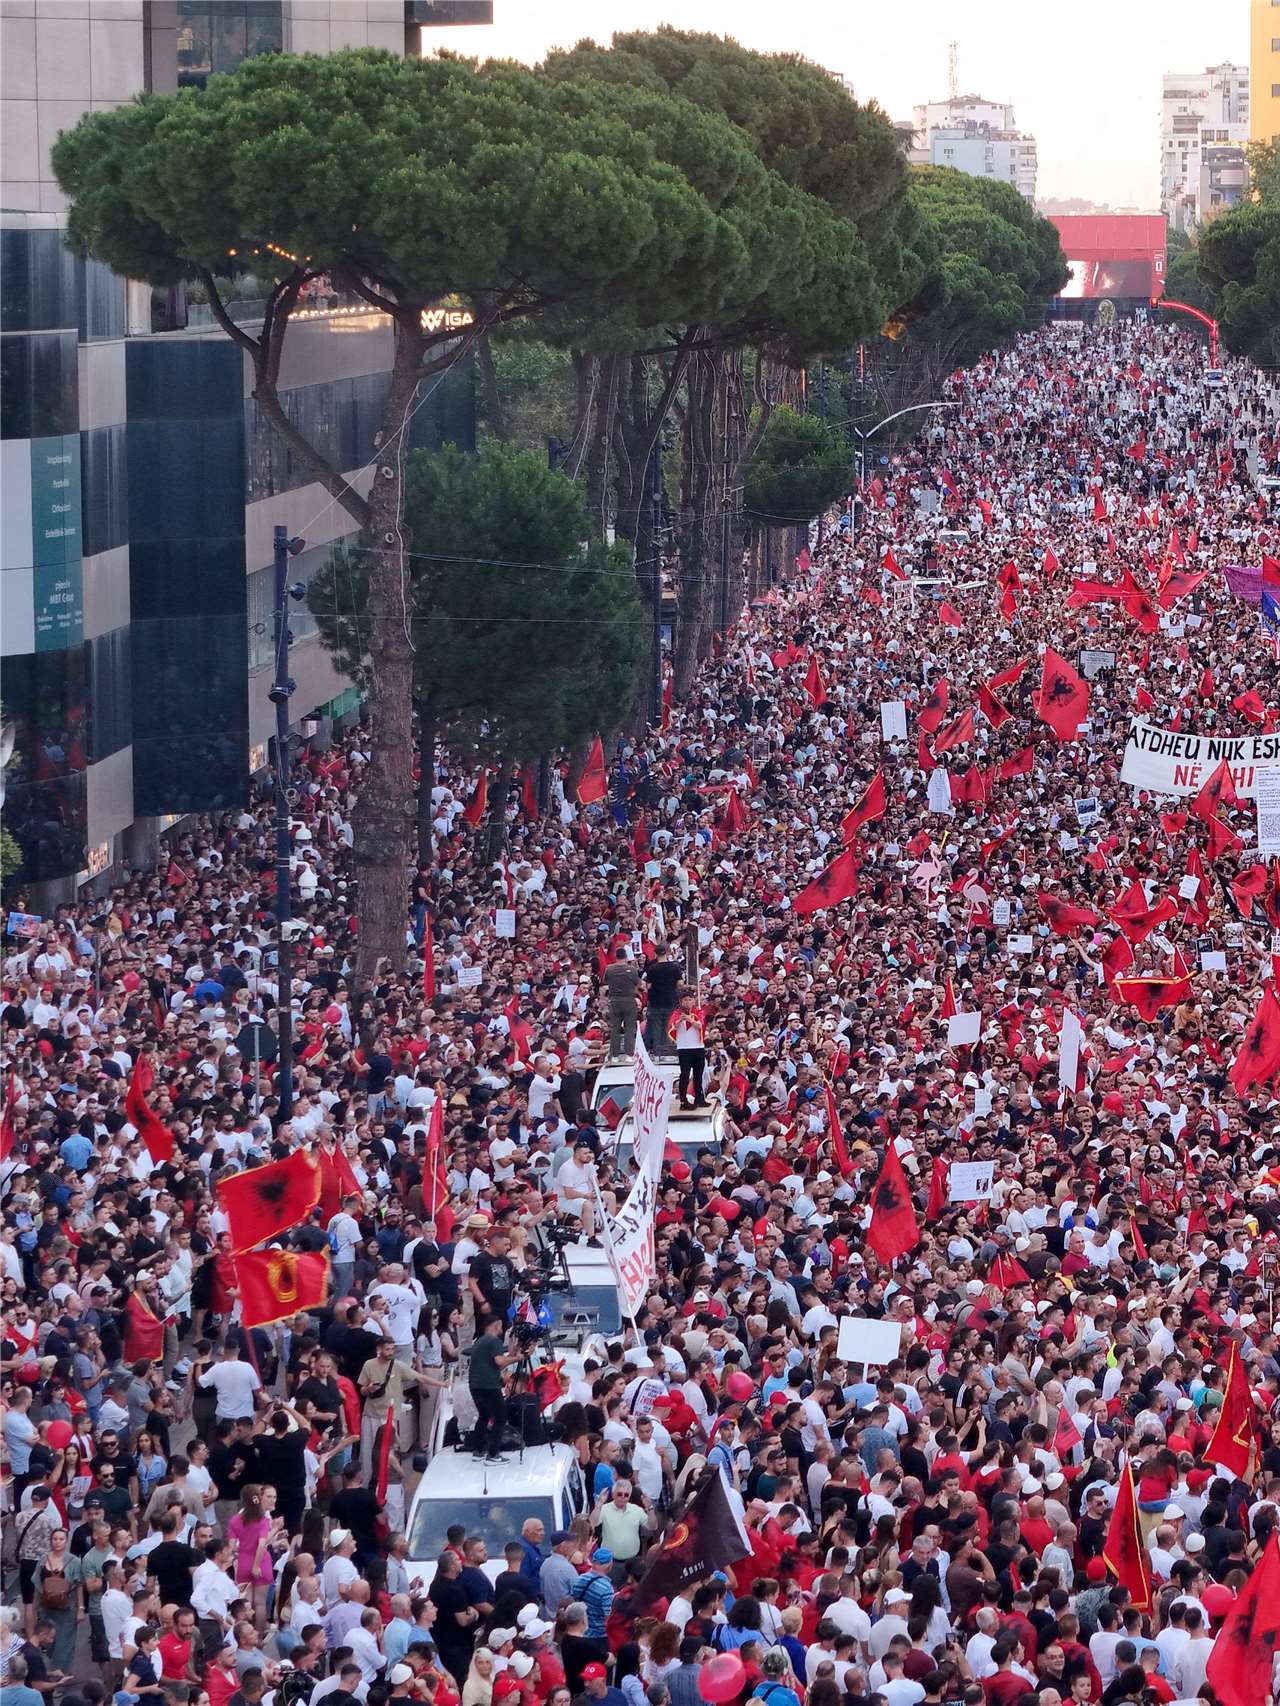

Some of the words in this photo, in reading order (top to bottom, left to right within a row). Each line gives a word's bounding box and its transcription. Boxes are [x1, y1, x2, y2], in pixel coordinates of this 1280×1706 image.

[1129, 725, 1201, 760] ATDHEU
[1207, 740, 1245, 761] NUK
[1173, 762, 1203, 787] NË
